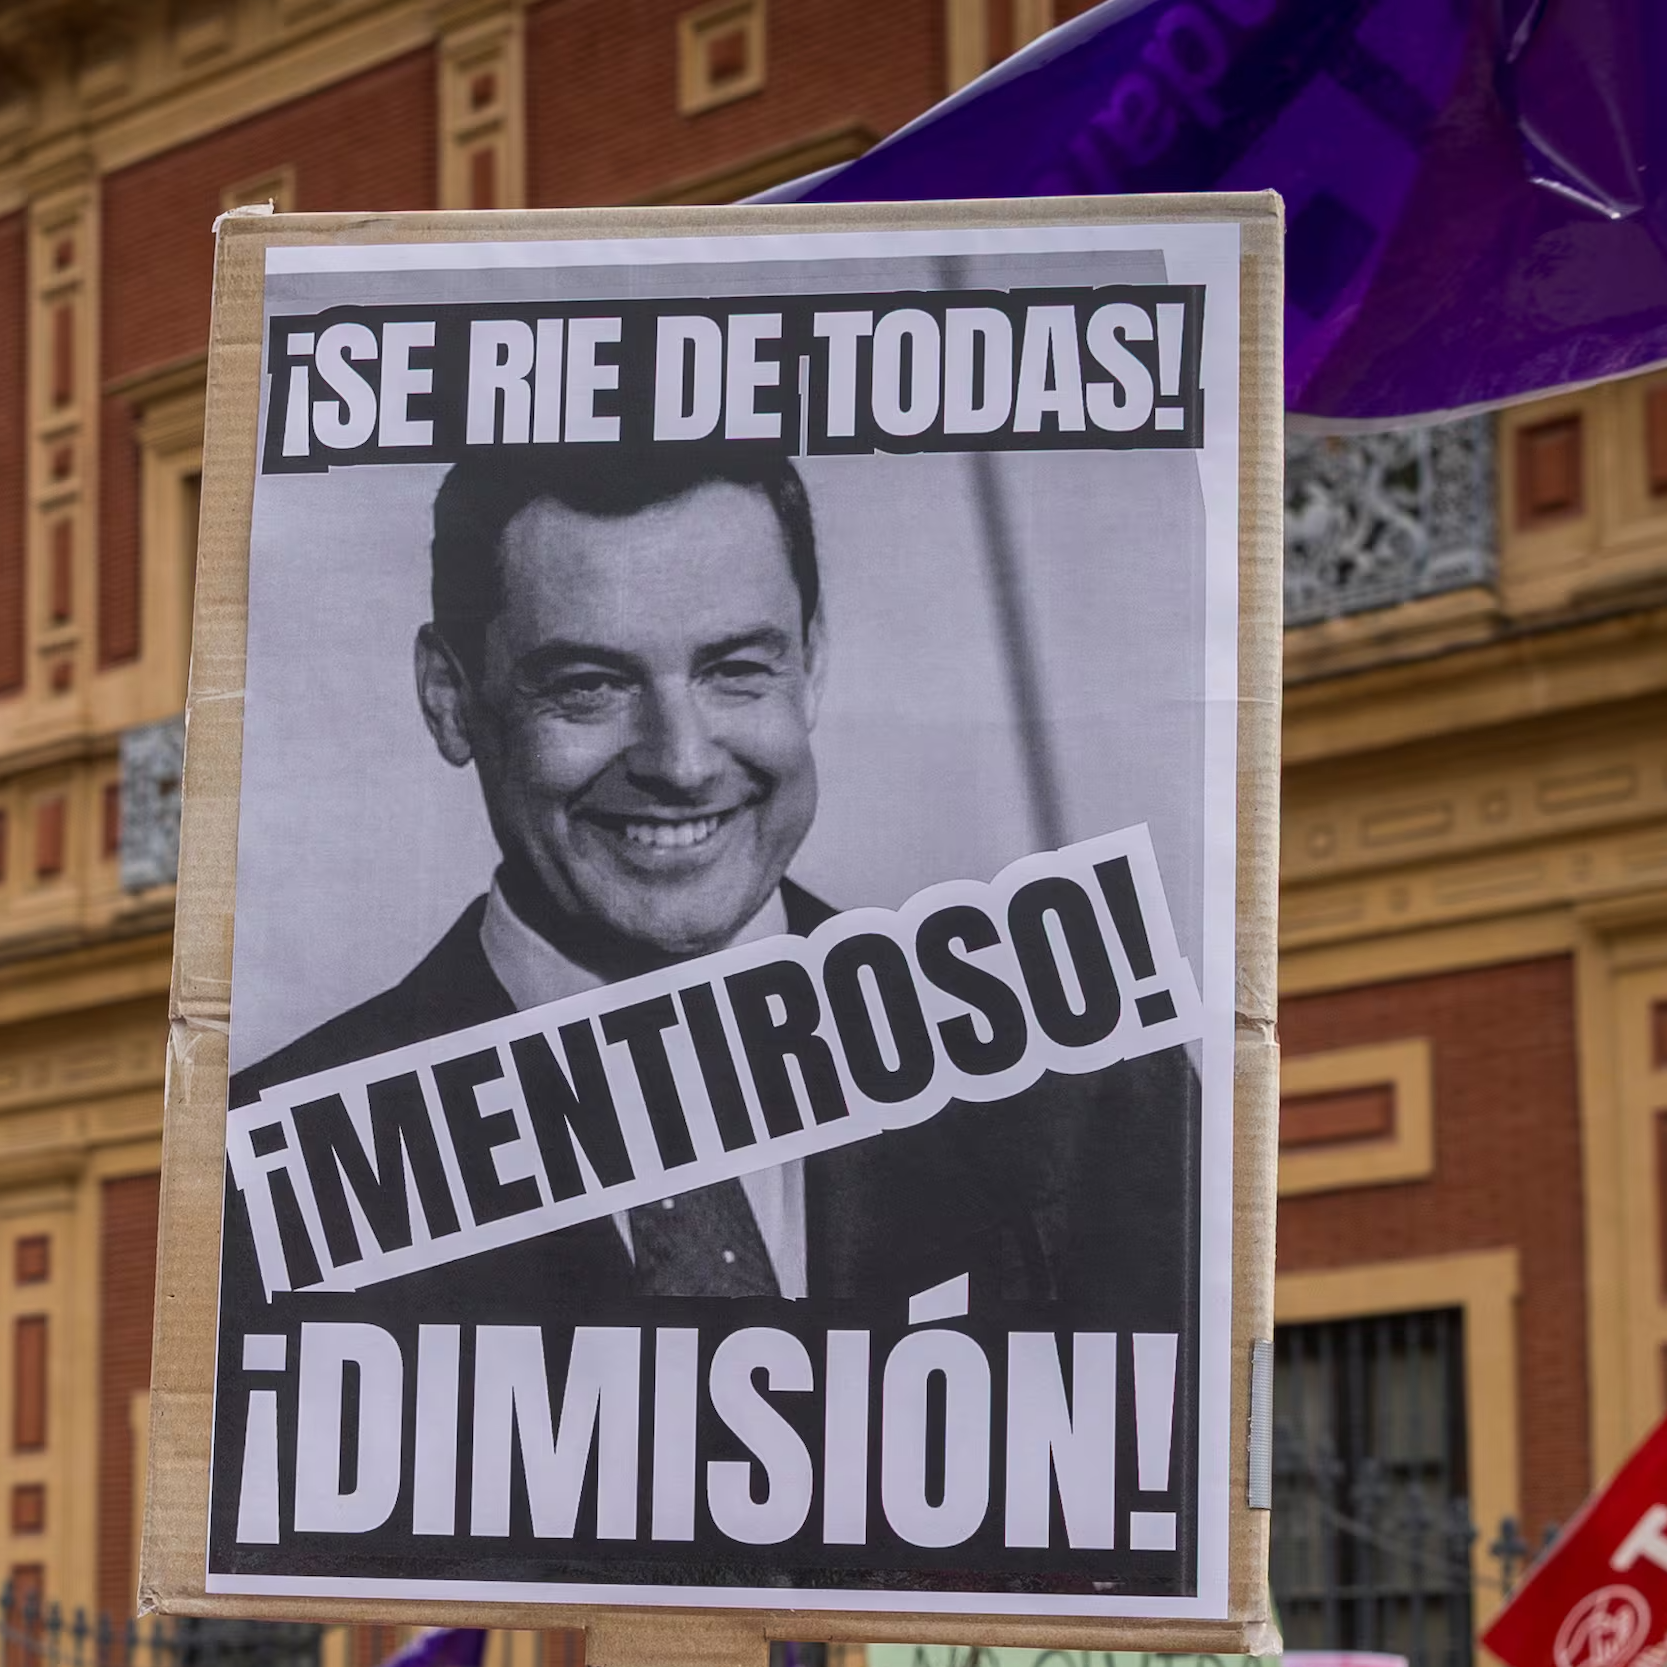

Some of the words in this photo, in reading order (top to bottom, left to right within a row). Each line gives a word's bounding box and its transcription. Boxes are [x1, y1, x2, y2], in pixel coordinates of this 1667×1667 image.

[282, 321, 436, 457] ¡SE
[465, 316, 623, 445] RIE
[653, 312, 783, 442] DE
[813, 302, 1186, 438] TODAS!
[248, 854, 1178, 1291] ¡MENTIROSO!
[235, 1271, 1179, 1552] ¡DIMISIÓN!
